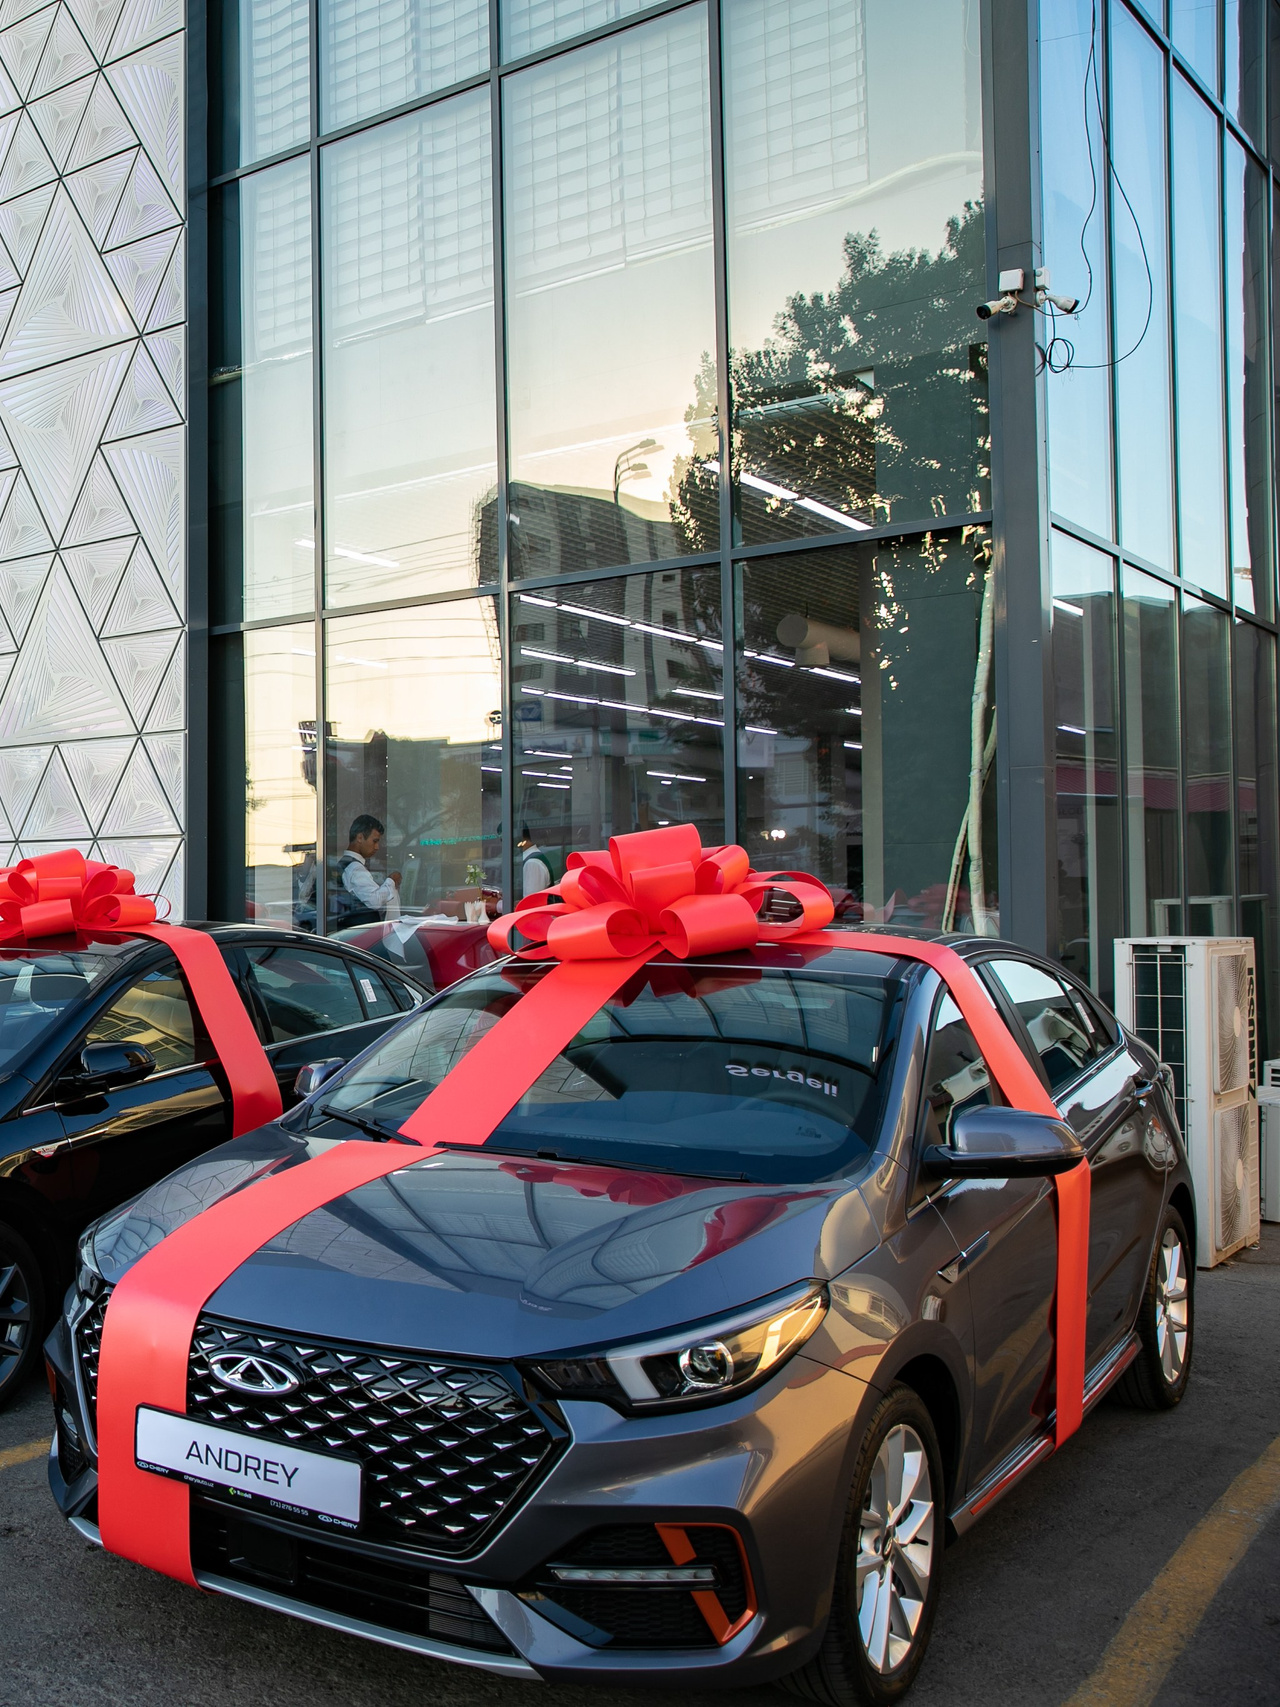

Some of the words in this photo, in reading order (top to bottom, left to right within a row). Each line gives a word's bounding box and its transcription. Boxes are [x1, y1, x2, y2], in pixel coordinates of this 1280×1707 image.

[1247, 967, 1256, 1101] ZANUSSI
[148, 1464, 169, 1474] CHERY
[185, 1440, 299, 1488] ANDREY
[183, 1475, 214, 1488] cheryauto.uz
[333, 1518, 358, 1530] CHERY
